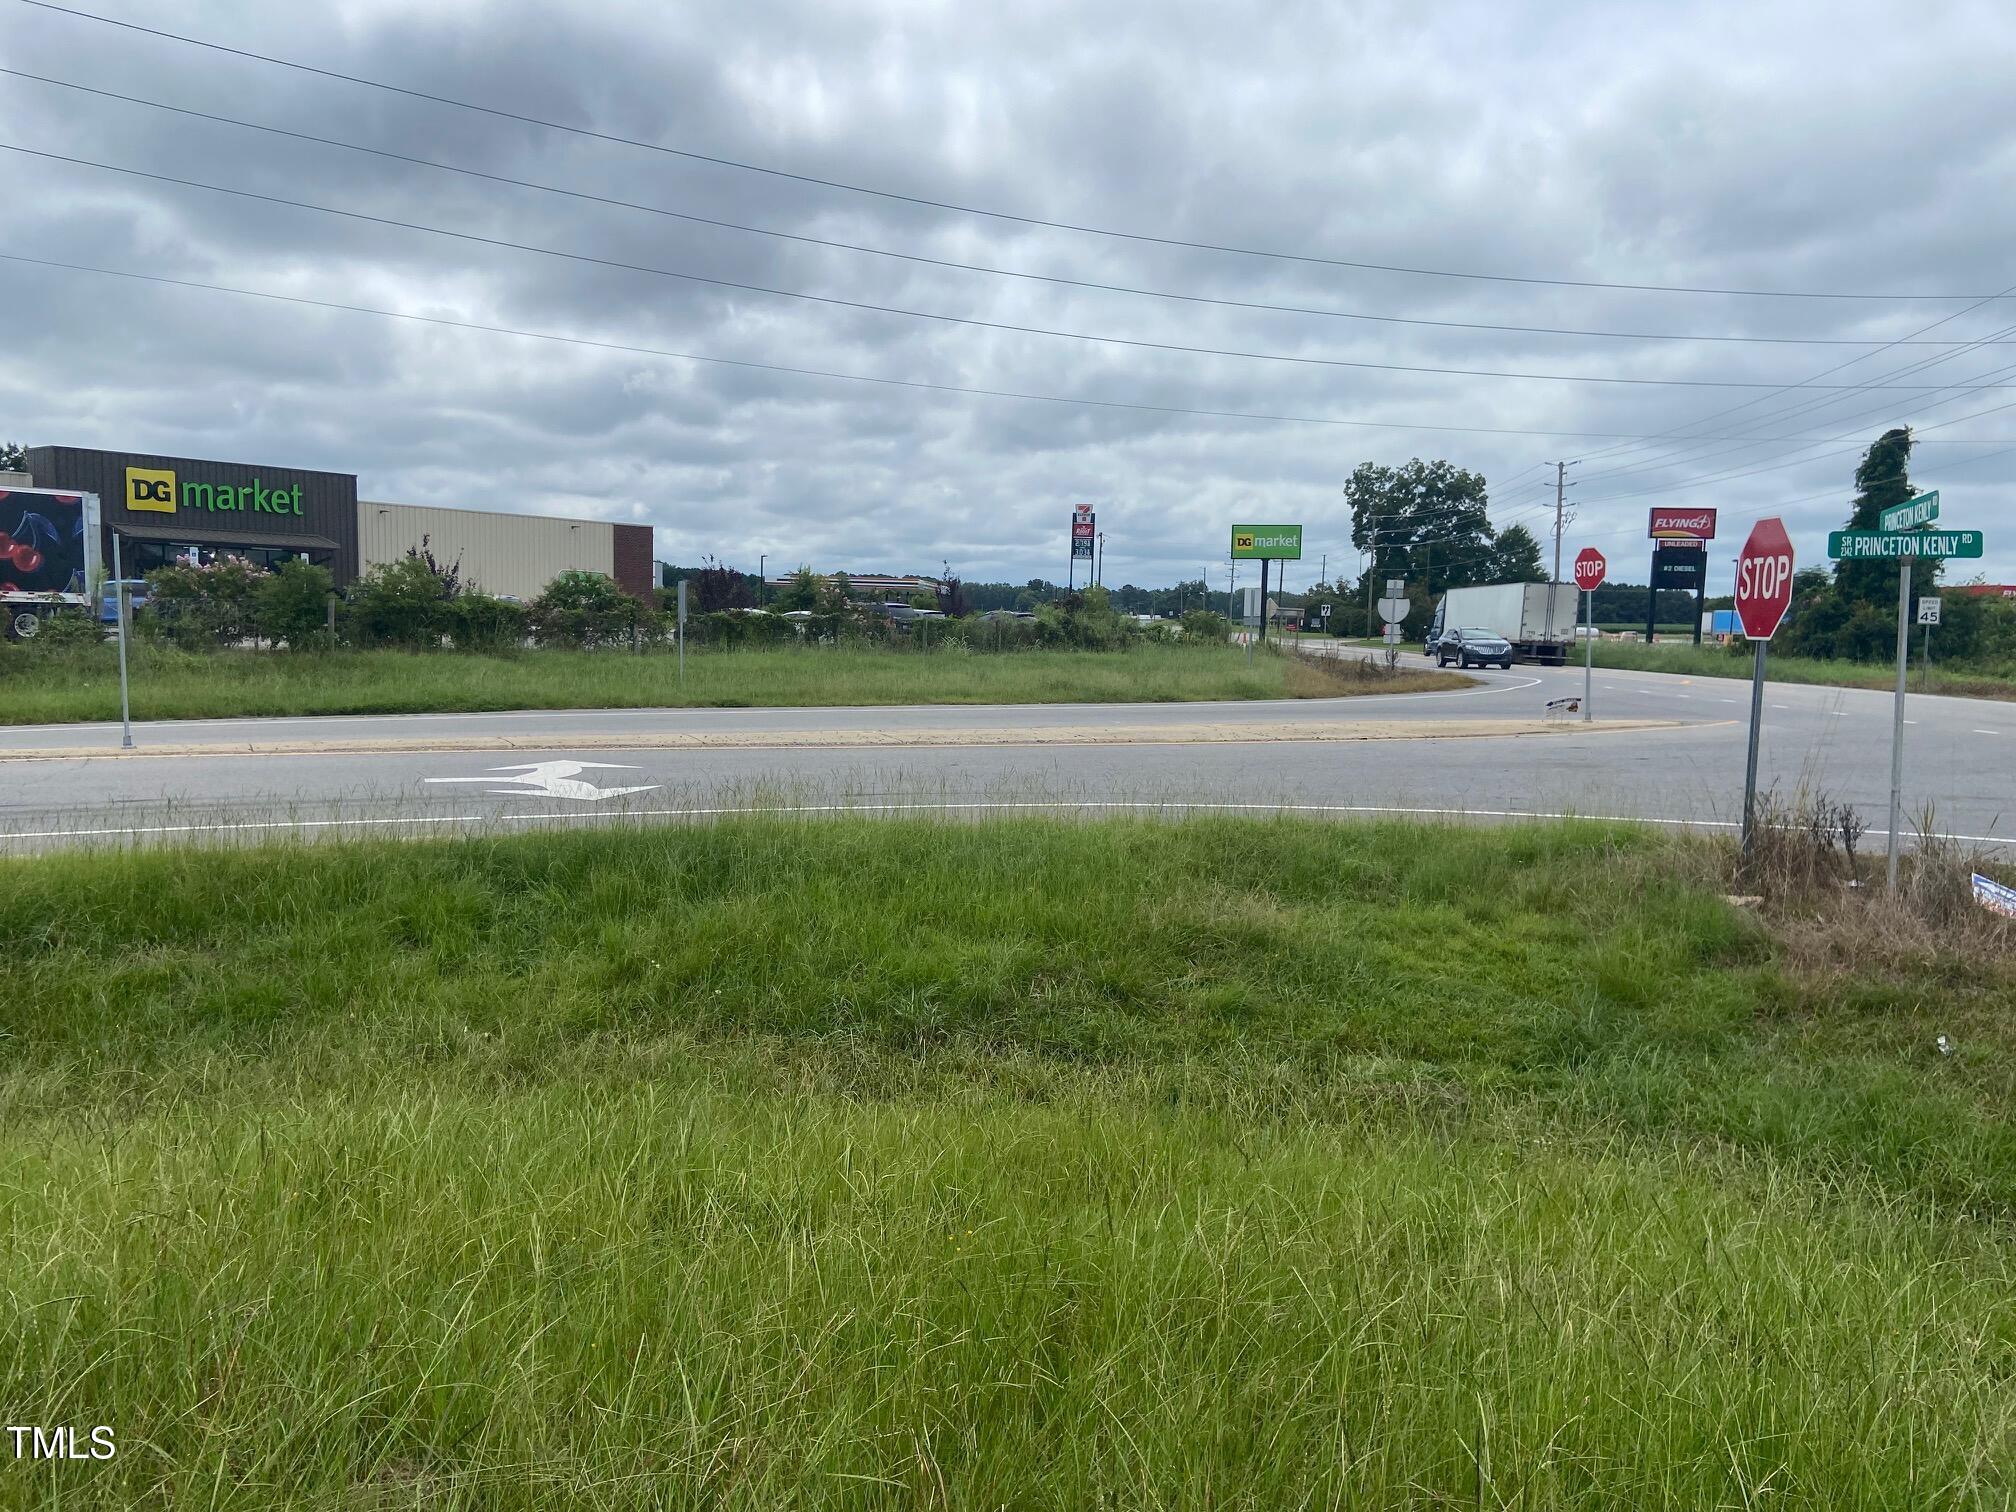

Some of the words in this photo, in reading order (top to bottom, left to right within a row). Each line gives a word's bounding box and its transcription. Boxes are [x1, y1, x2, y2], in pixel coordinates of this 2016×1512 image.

[132, 479, 171, 502] DG
[181, 478, 304, 516] market
[1885, 506, 1914, 531] PRINCETON
[1914, 501, 1931, 524] KENLY
[1932, 496, 1938, 507] RD
[1655, 518, 1697, 528] FLYING
[1237, 538, 1252, 547] DG
[1254, 535, 1298, 548] market
[1841, 536, 1852, 546] SR
[1854, 537, 1920, 556] PRINCETON
[1923, 536, 1959, 555] KENLY
[1961, 533, 1973, 544] RD
[1576, 560, 1603, 577] STOP
[1740, 555, 1790, 600] STOP
[1920, 612, 1938, 621] 45
